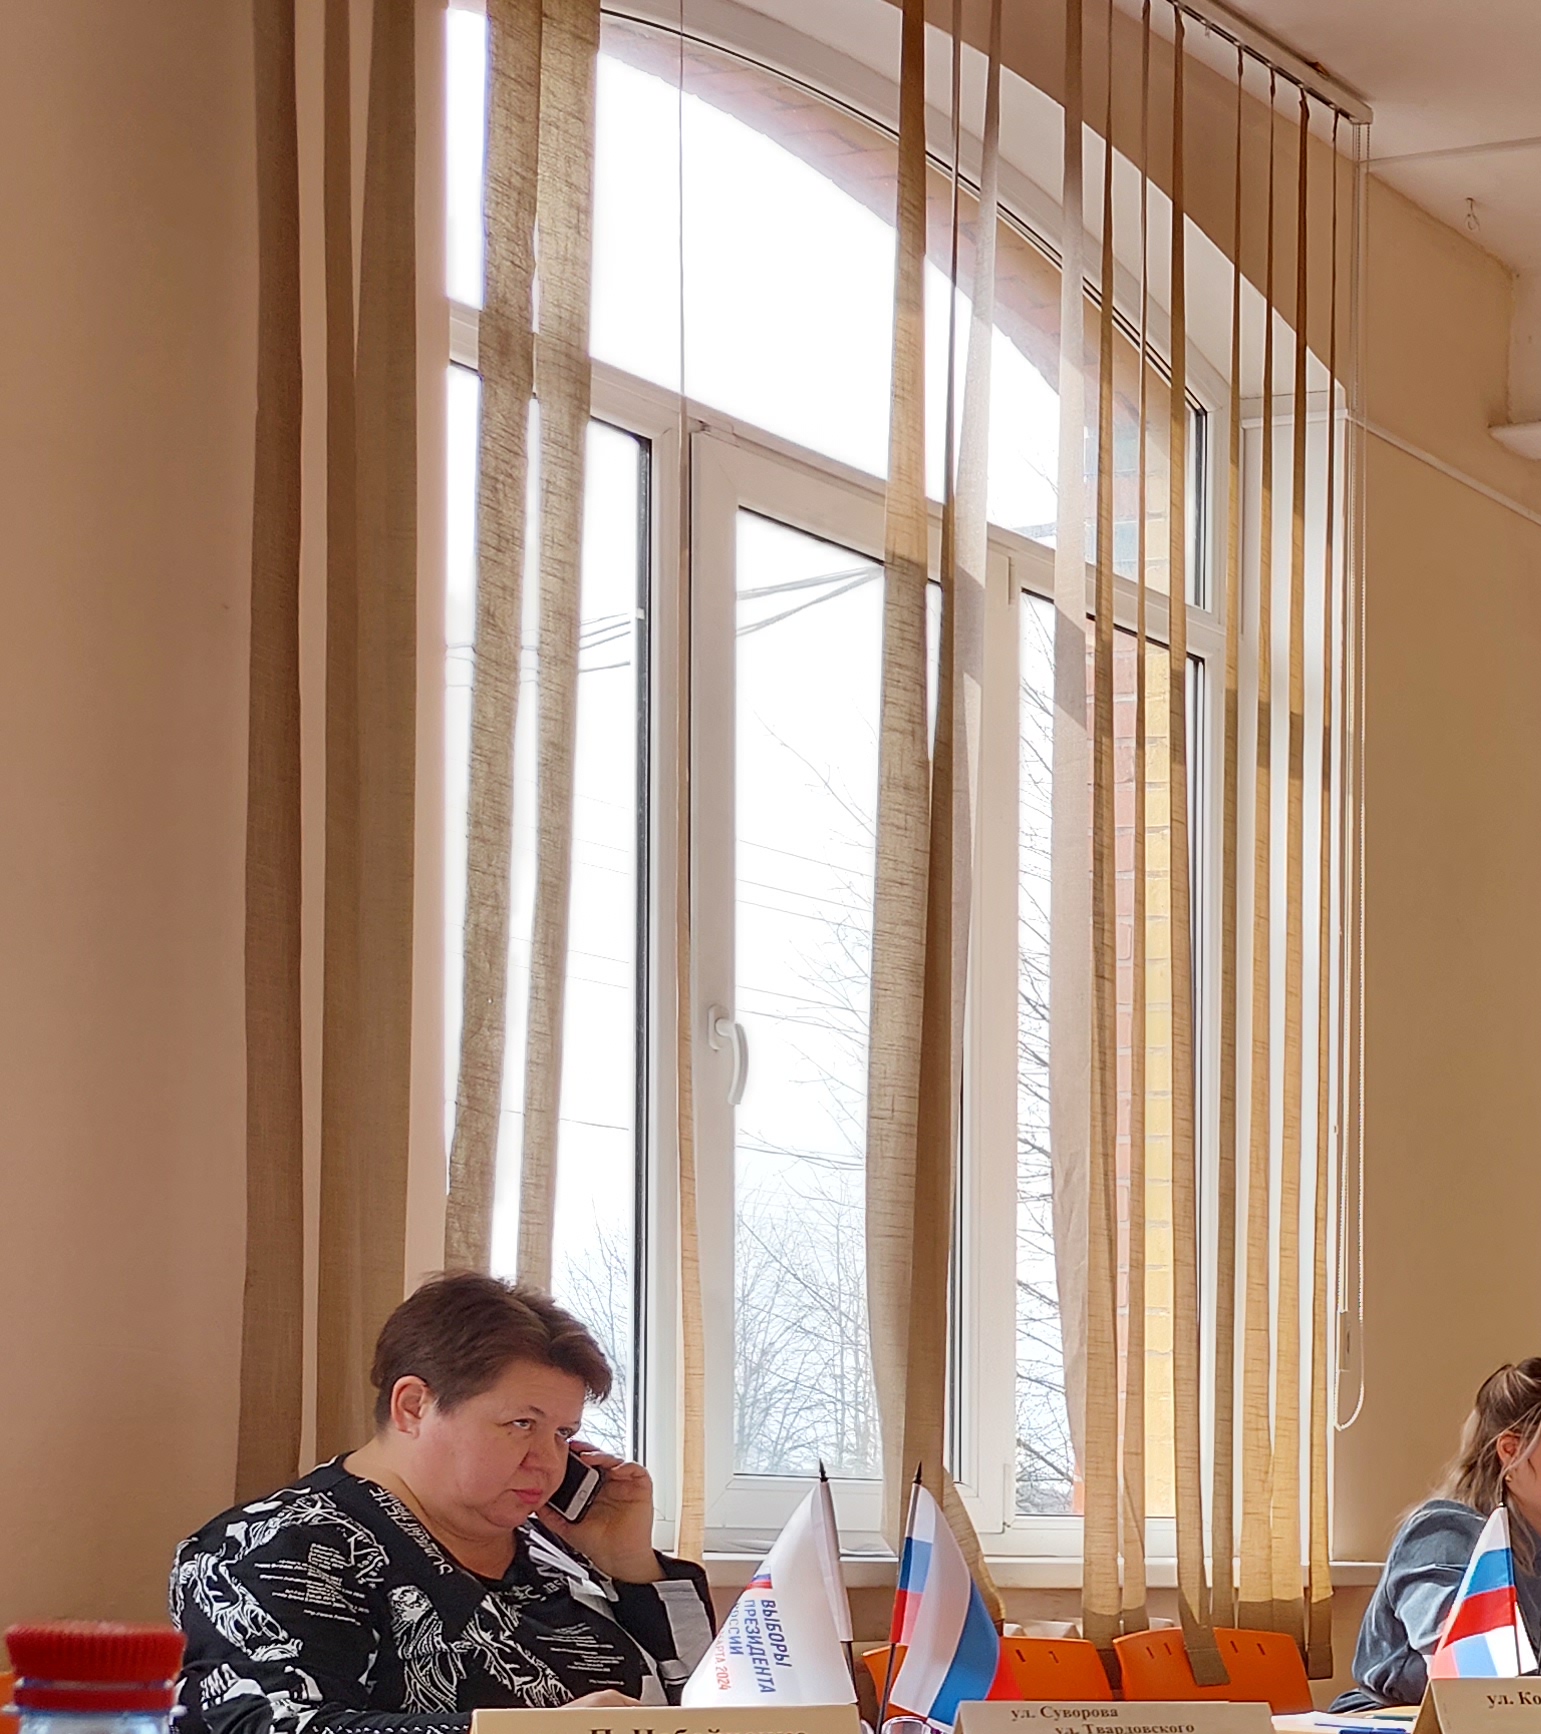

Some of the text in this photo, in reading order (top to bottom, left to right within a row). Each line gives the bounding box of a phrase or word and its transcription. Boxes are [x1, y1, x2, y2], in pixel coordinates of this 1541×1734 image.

[760, 1599, 793, 1668] ВЫБОРЫ
[744, 1599, 777, 1693] ПРЕЗИДЕНТА
[715, 1667, 732, 1690] 2024
[1487, 1694, 1514, 1708] ул.
[1011, 1706, 1118, 1721] ул. Суворова
